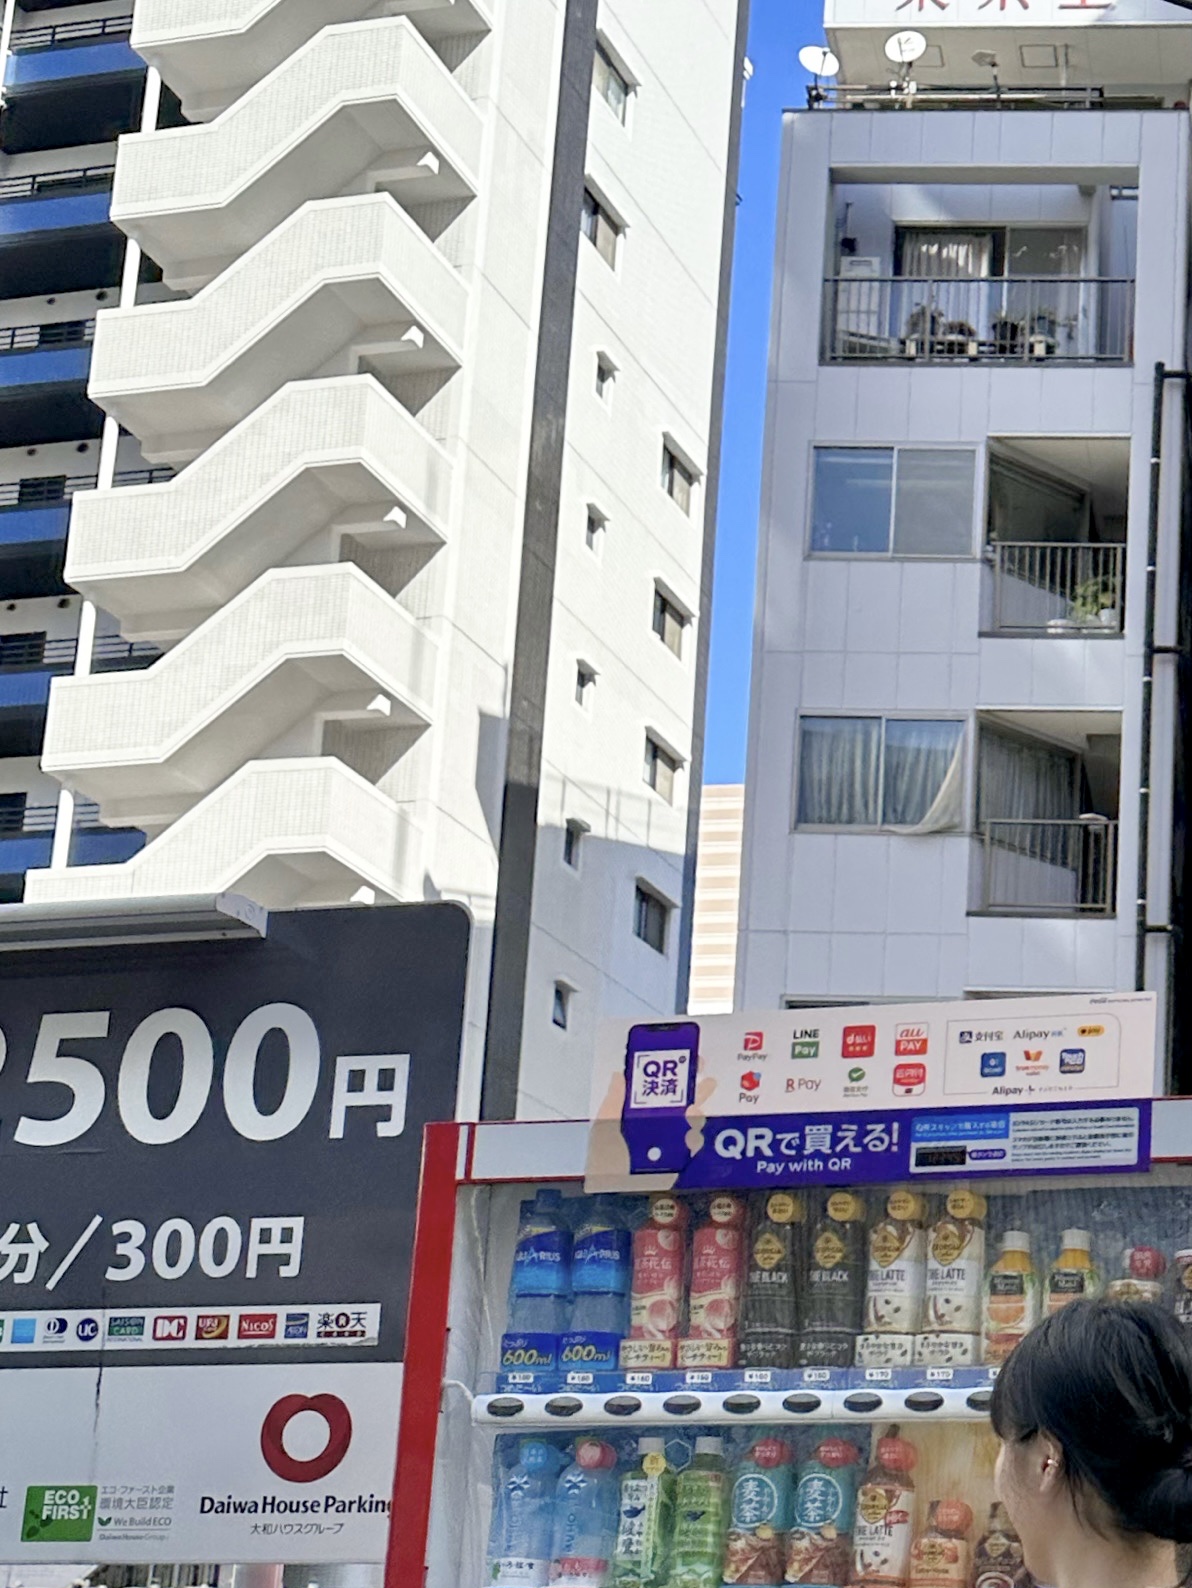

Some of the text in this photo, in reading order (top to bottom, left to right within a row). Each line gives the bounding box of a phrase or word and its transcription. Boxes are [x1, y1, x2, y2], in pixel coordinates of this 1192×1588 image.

[793, 1029, 820, 1040] LINE
[900, 1027, 924, 1038] au
[1013, 1029, 1050, 1042] Alipay
[794, 1042, 816, 1057] Pay
[900, 1040, 924, 1051] PAY
[737, 1052, 768, 1062] PayPay
[0, 1003, 410, 1146] 500円
[642, 1060, 678, 1079] QR
[642, 1078, 680, 1097] 決済
[798, 1078, 822, 1092] Pay
[991, 1085, 1024, 1097] Alipay
[739, 1093, 760, 1104] Pay
[714, 1121, 900, 1161] QRで買える!
[756, 1157, 852, 1175] Pay with QR
[762, 1271, 788, 1283] BLACK
[822, 1271, 848, 1282] BLACK
[881, 1269, 905, 1281] LATTE
[941, 1268, 966, 1280] LATTE
[78, 1323, 97, 1337] UC
[502, 1349, 553, 1366] 600ml
[561, 1344, 611, 1362] 600ml
[43, 1489, 79, 1506] ECO
[100, 1496, 174, 1511] 環境大臣認定
[740, 1479, 761, 1522] 麦茶
[803, 1478, 826, 1522] 麦茶
[41, 1501, 91, 1520] FIRST
[200, 1495, 258, 1515] Daiwa
[262, 1495, 320, 1515] House
[114, 1516, 172, 1527] We Build ECO
[250, 1522, 345, 1536] 大和ハウスグループ
[869, 1525, 893, 1537] LATTE
